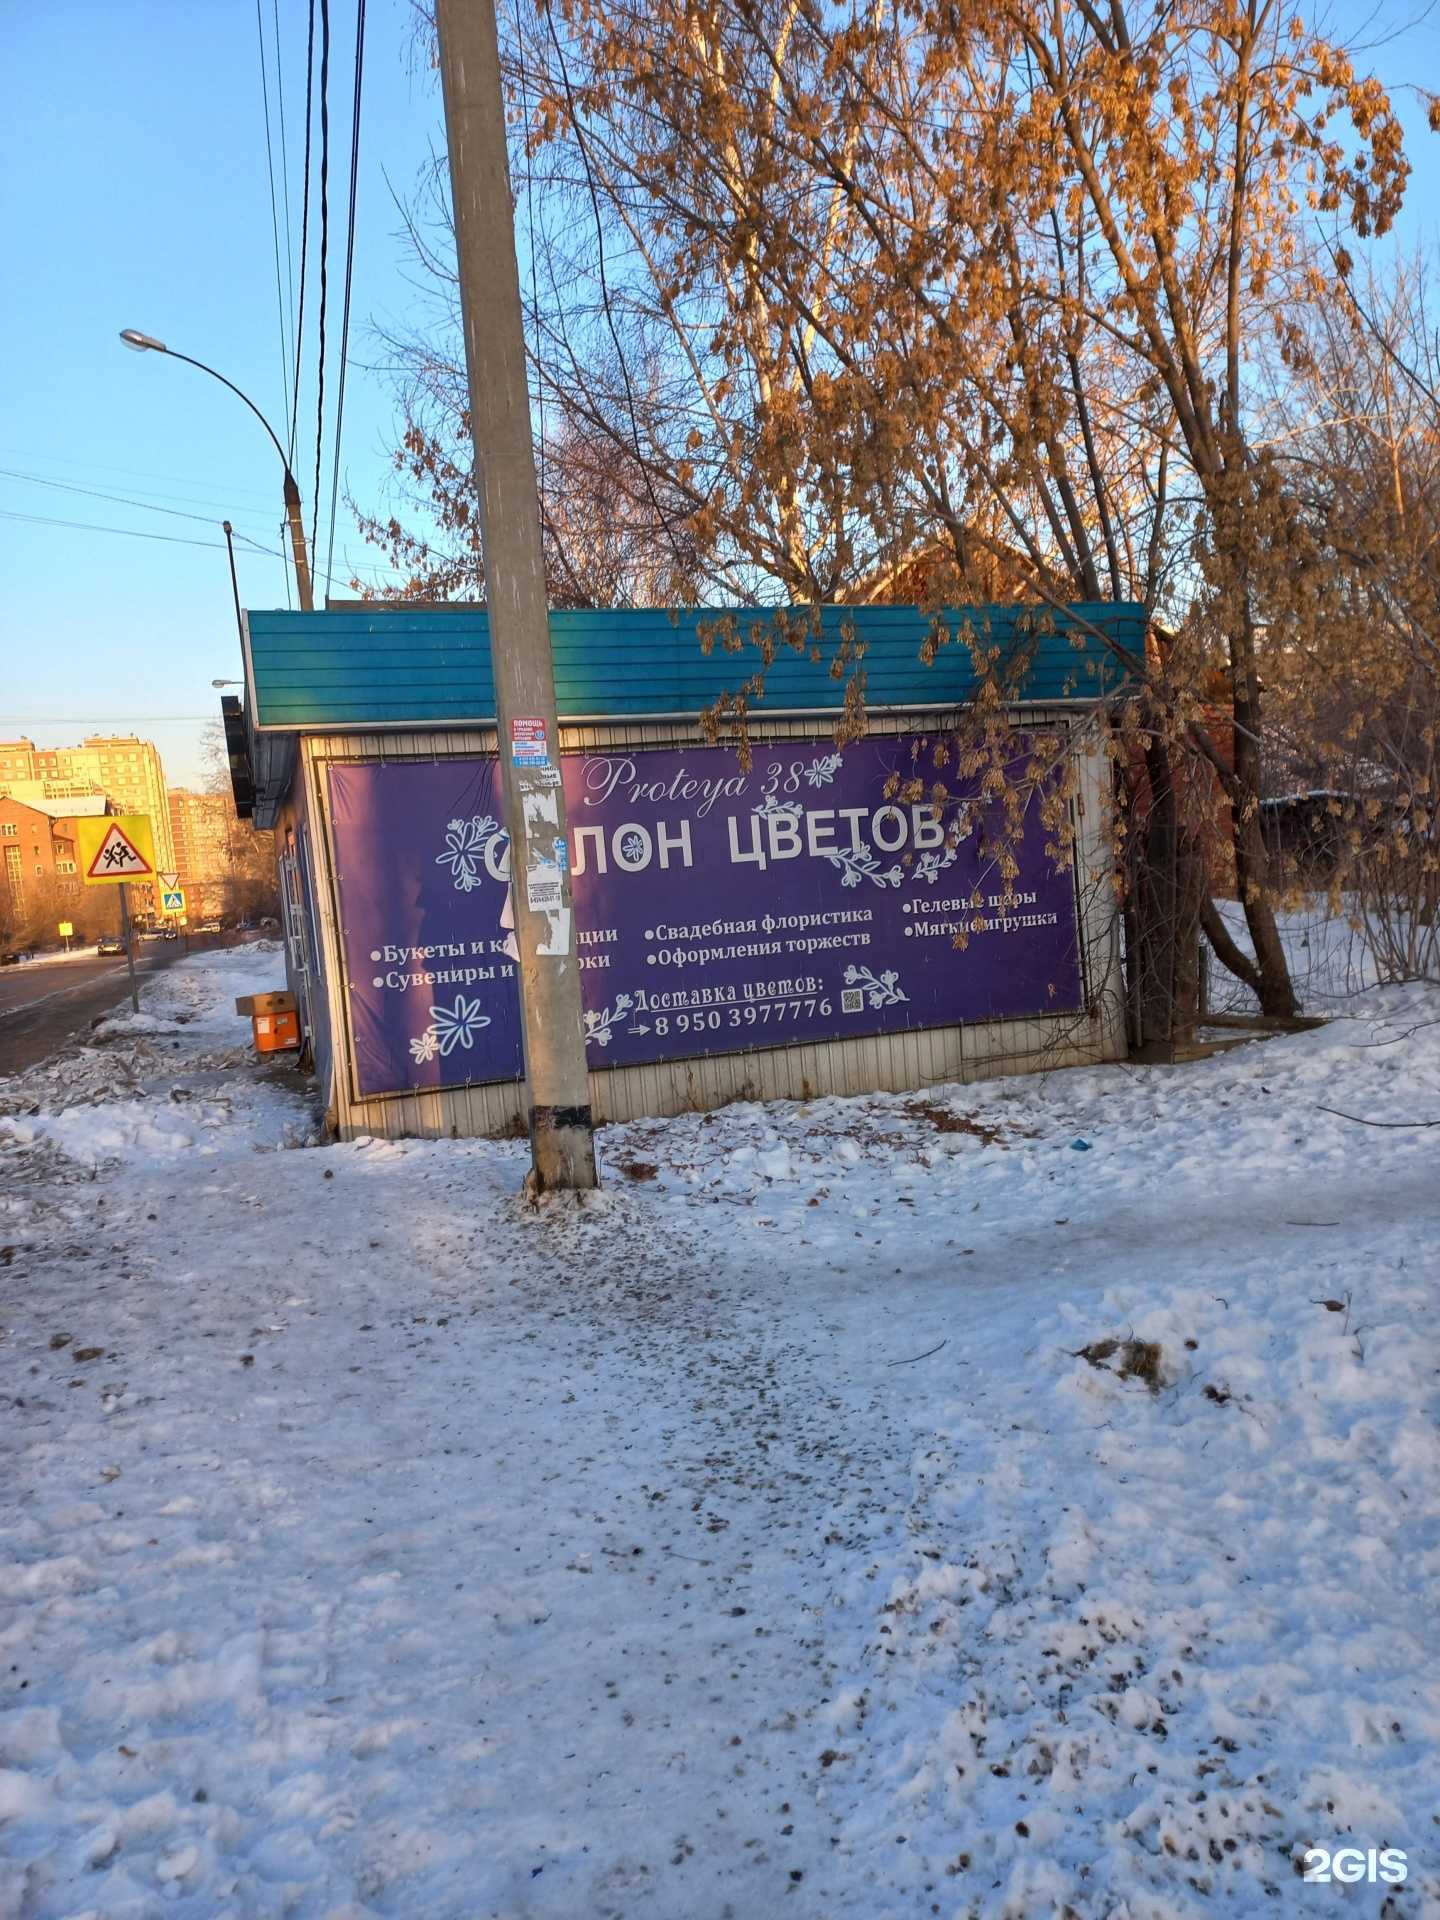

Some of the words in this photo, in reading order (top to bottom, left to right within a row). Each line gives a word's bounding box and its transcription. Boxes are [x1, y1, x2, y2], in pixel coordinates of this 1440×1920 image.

[581, 757, 749, 818] Proteya
[761, 761, 804, 795] 38
[484, 819, 693, 882] СЛОН
[728, 804, 945, 871] ЦВЕТОВ
[656, 918, 757, 941] Свадебная
[761, 908, 873, 934] флористика
[983, 912, 1058, 933] игрушки
[383, 940, 466, 965] Букеты
[471, 941, 484, 955] и
[658, 939, 782, 968] Оформления
[786, 931, 872, 952] торжеств
[386, 965, 495, 992] Сувениры
[500, 965, 514, 978] и
[634, 984, 737, 1013] Доставка
[743, 975, 824, 1003] цветов:
[655, 1017, 669, 1036] 8
[676, 1010, 721, 1033] 950
[728, 998, 832, 1027] 3977776
